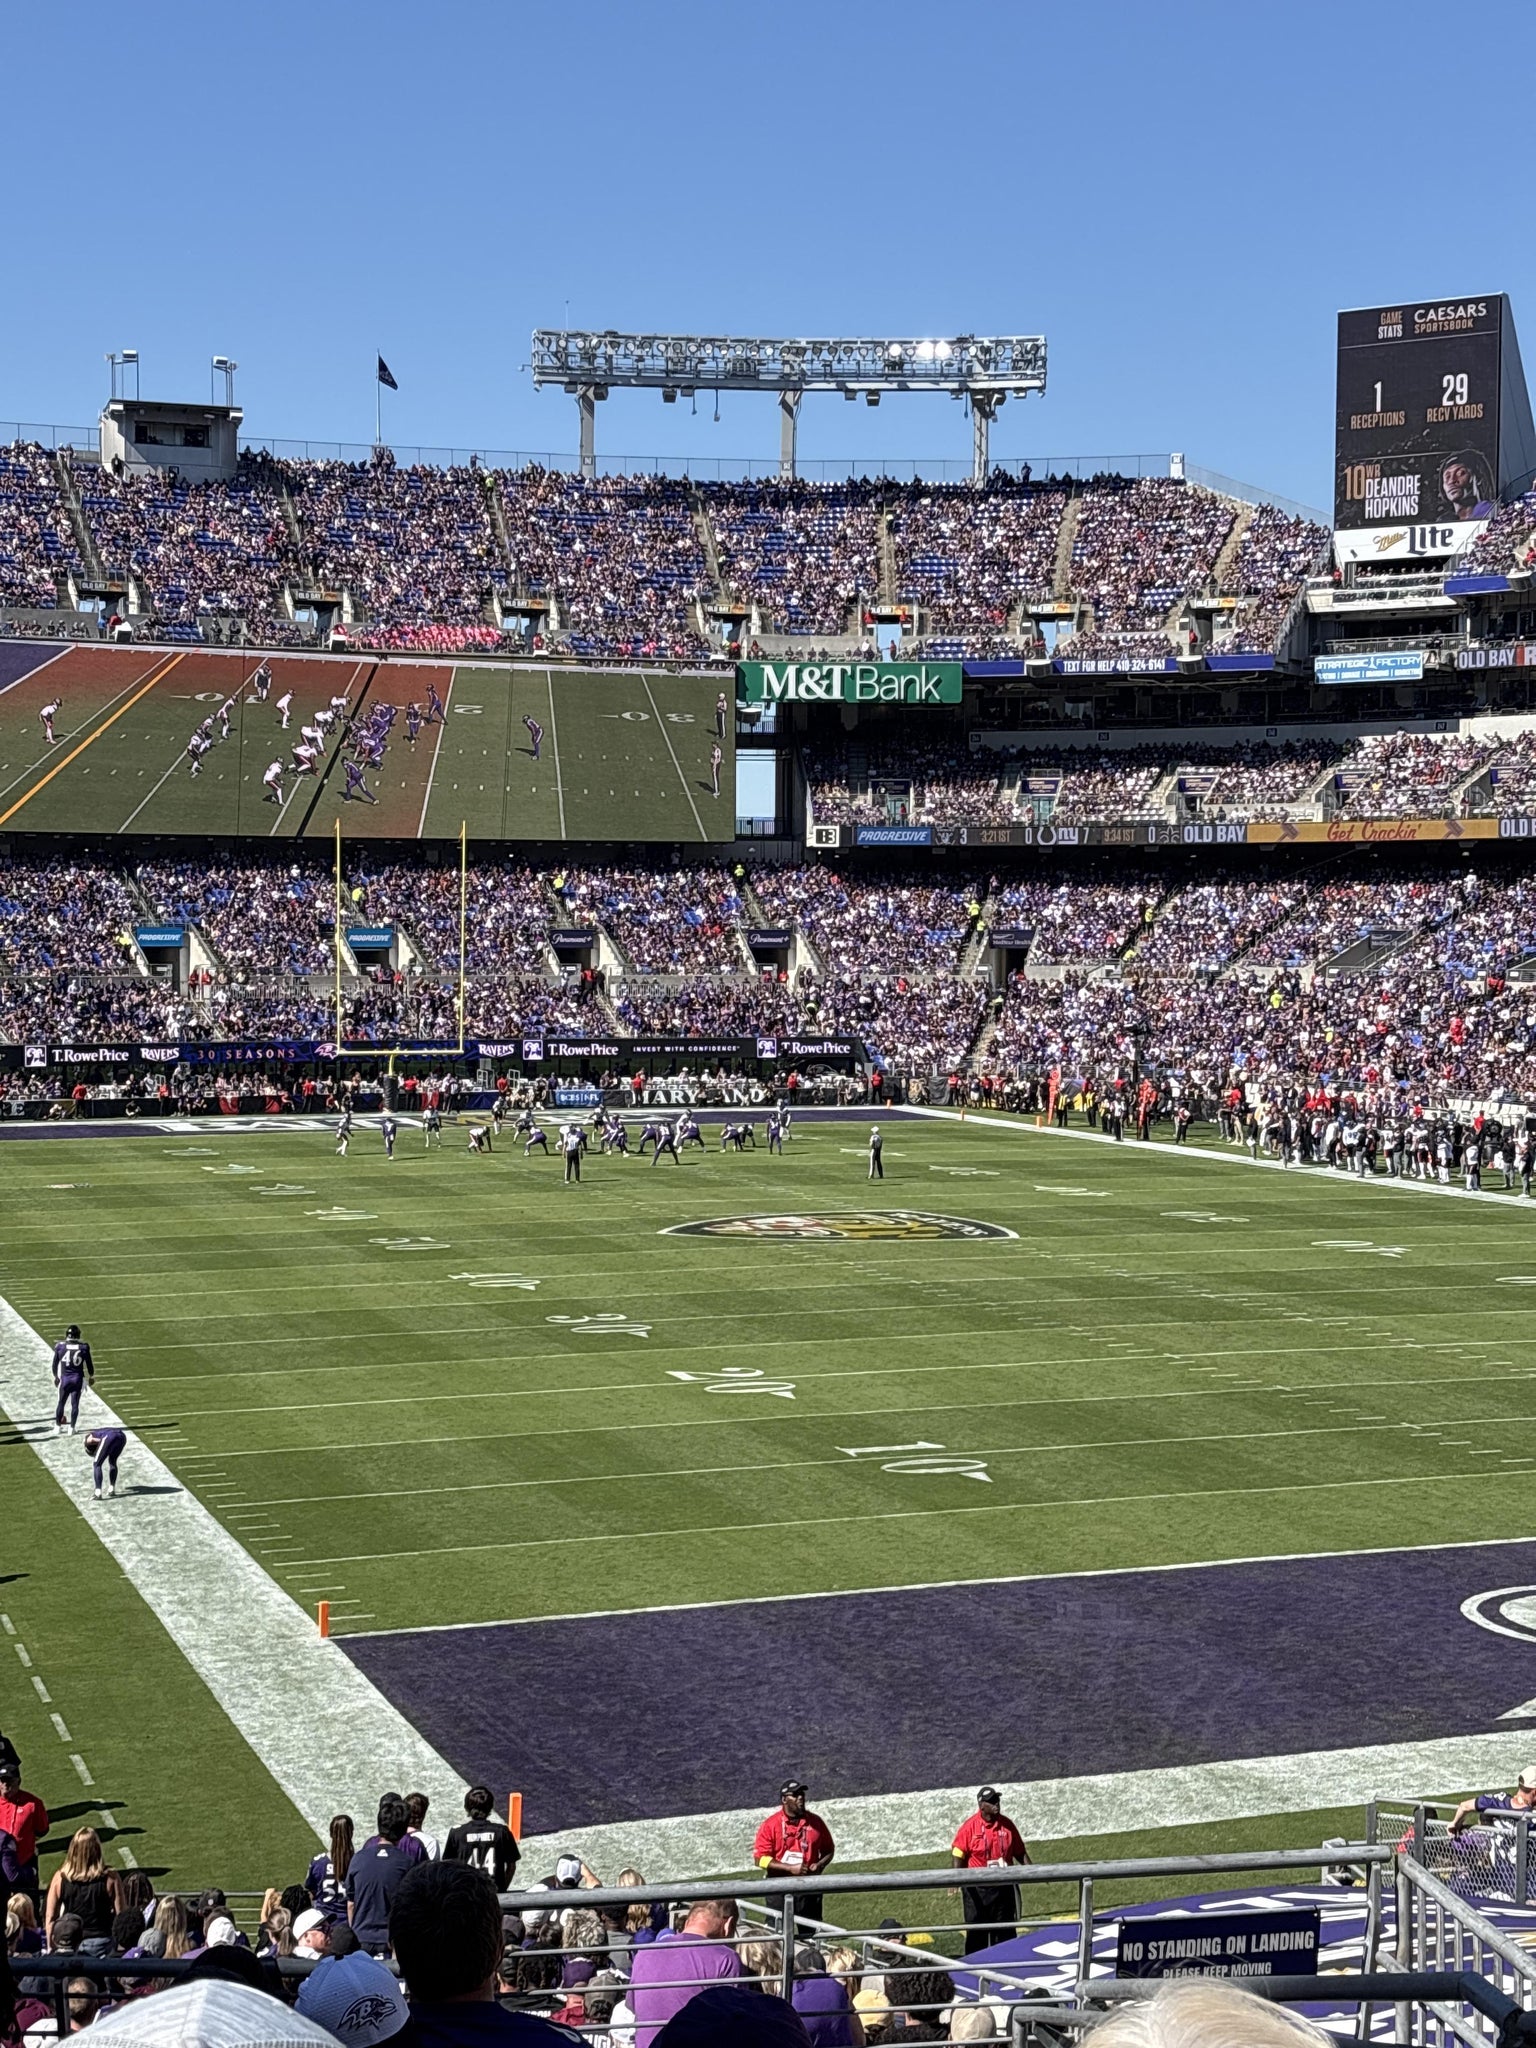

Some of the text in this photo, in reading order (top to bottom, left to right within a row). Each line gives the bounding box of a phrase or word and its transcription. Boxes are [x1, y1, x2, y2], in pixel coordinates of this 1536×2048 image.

[1381, 312, 1403, 325] GAME
[1414, 303, 1487, 323] CAESARS
[1378, 325, 1403, 340] STATS
[1414, 319, 1474, 334] SPORTSBOOK
[1374, 381, 1382, 412] 1
[1442, 373, 1468, 406] 29
[1350, 411, 1405, 430] RECEPTIONS
[1427, 403, 1484, 423] RECV YARDS
[1366, 464, 1381, 477] WR
[1344, 465, 1365, 500] 10
[1365, 475, 1421, 498] DEANDRE
[1365, 497, 1419, 519] HOPKINS
[1407, 527, 1454, 555] Lite
[1063, 661, 1080, 672] TEXT
[1097, 660, 1114, 672] HELP
[1459, 651, 1487, 669] OLD
[1489, 649, 1516, 667] BAY
[760, 665, 942, 700] M&T Bank
[858, 831, 928, 842] PROGRESSIVE
[960, 828, 968, 845] 3
[1025, 827, 1033, 845] 0
[1083, 827, 1090, 845] 7
[1148, 826, 1156, 843] 0
[1183, 825, 1247, 843] OLD BAY
[1327, 820, 1421, 841] Get Crackin'
[1501, 819, 1527, 837] OLD
[141, 1047, 180, 1062] RAVENS
[197, 1049, 295, 1059] 30 SEASONS
[478, 1043, 515, 1058] RAVENS
[632, 1089, 766, 1104] ARYAND
[545, 1313, 653, 1335] 30
[61, 1350, 83, 1367] 46
[665, 1367, 797, 1395] 20
[834, 1440, 989, 1476] 10
[1123, 1931, 1315, 1962] NO STANDING ON LANDING
[1163, 1962, 1272, 1979] PLEASE KEEP MOVING
